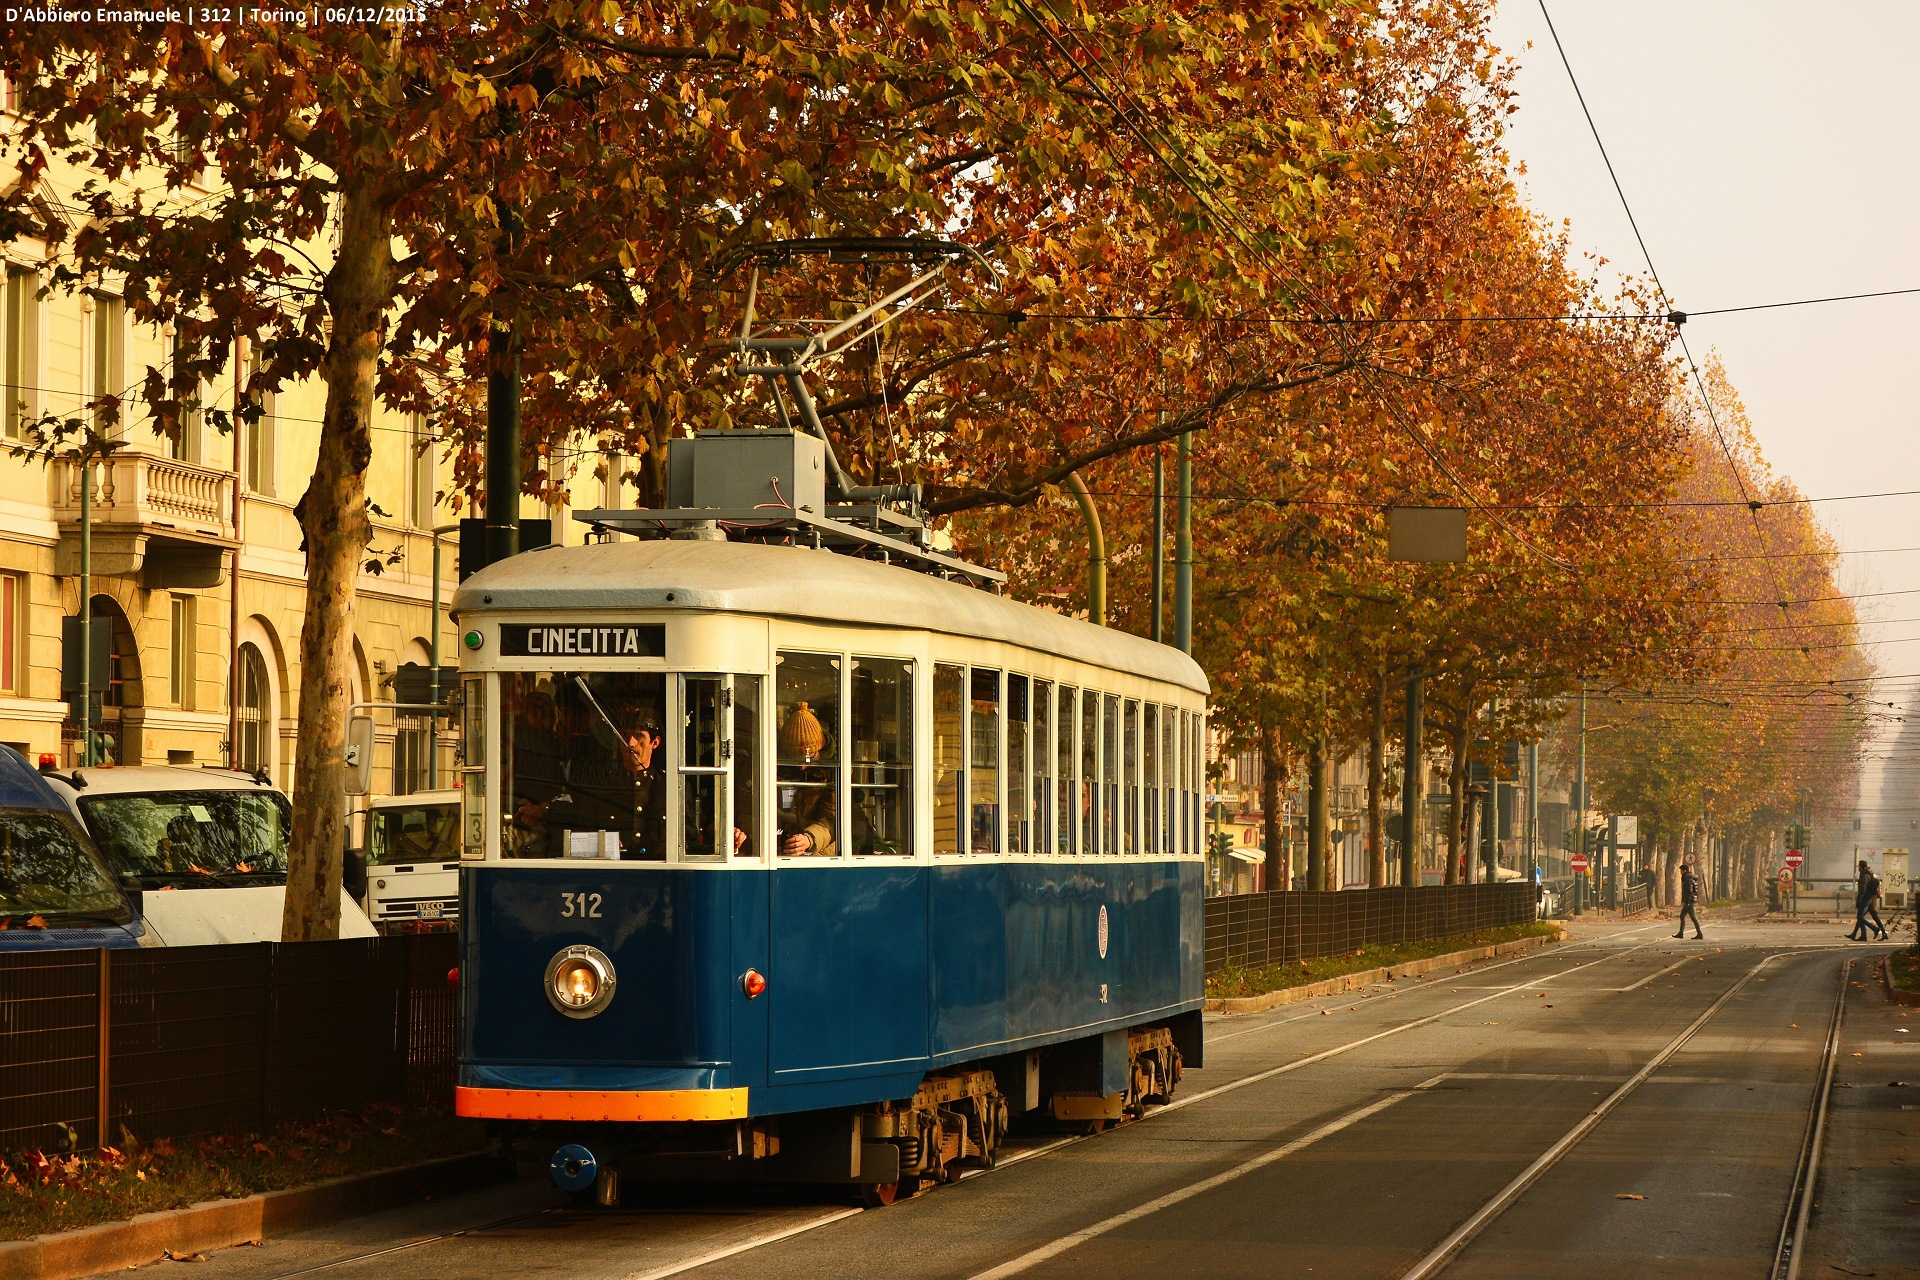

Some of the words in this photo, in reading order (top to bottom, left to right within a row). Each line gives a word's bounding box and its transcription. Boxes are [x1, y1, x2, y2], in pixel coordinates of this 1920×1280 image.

[472, 818, 482, 843] 3
[415, 902, 445, 910] IVECO
[561, 893, 602, 918] 312
[1100, 984, 1108, 1004] 312
